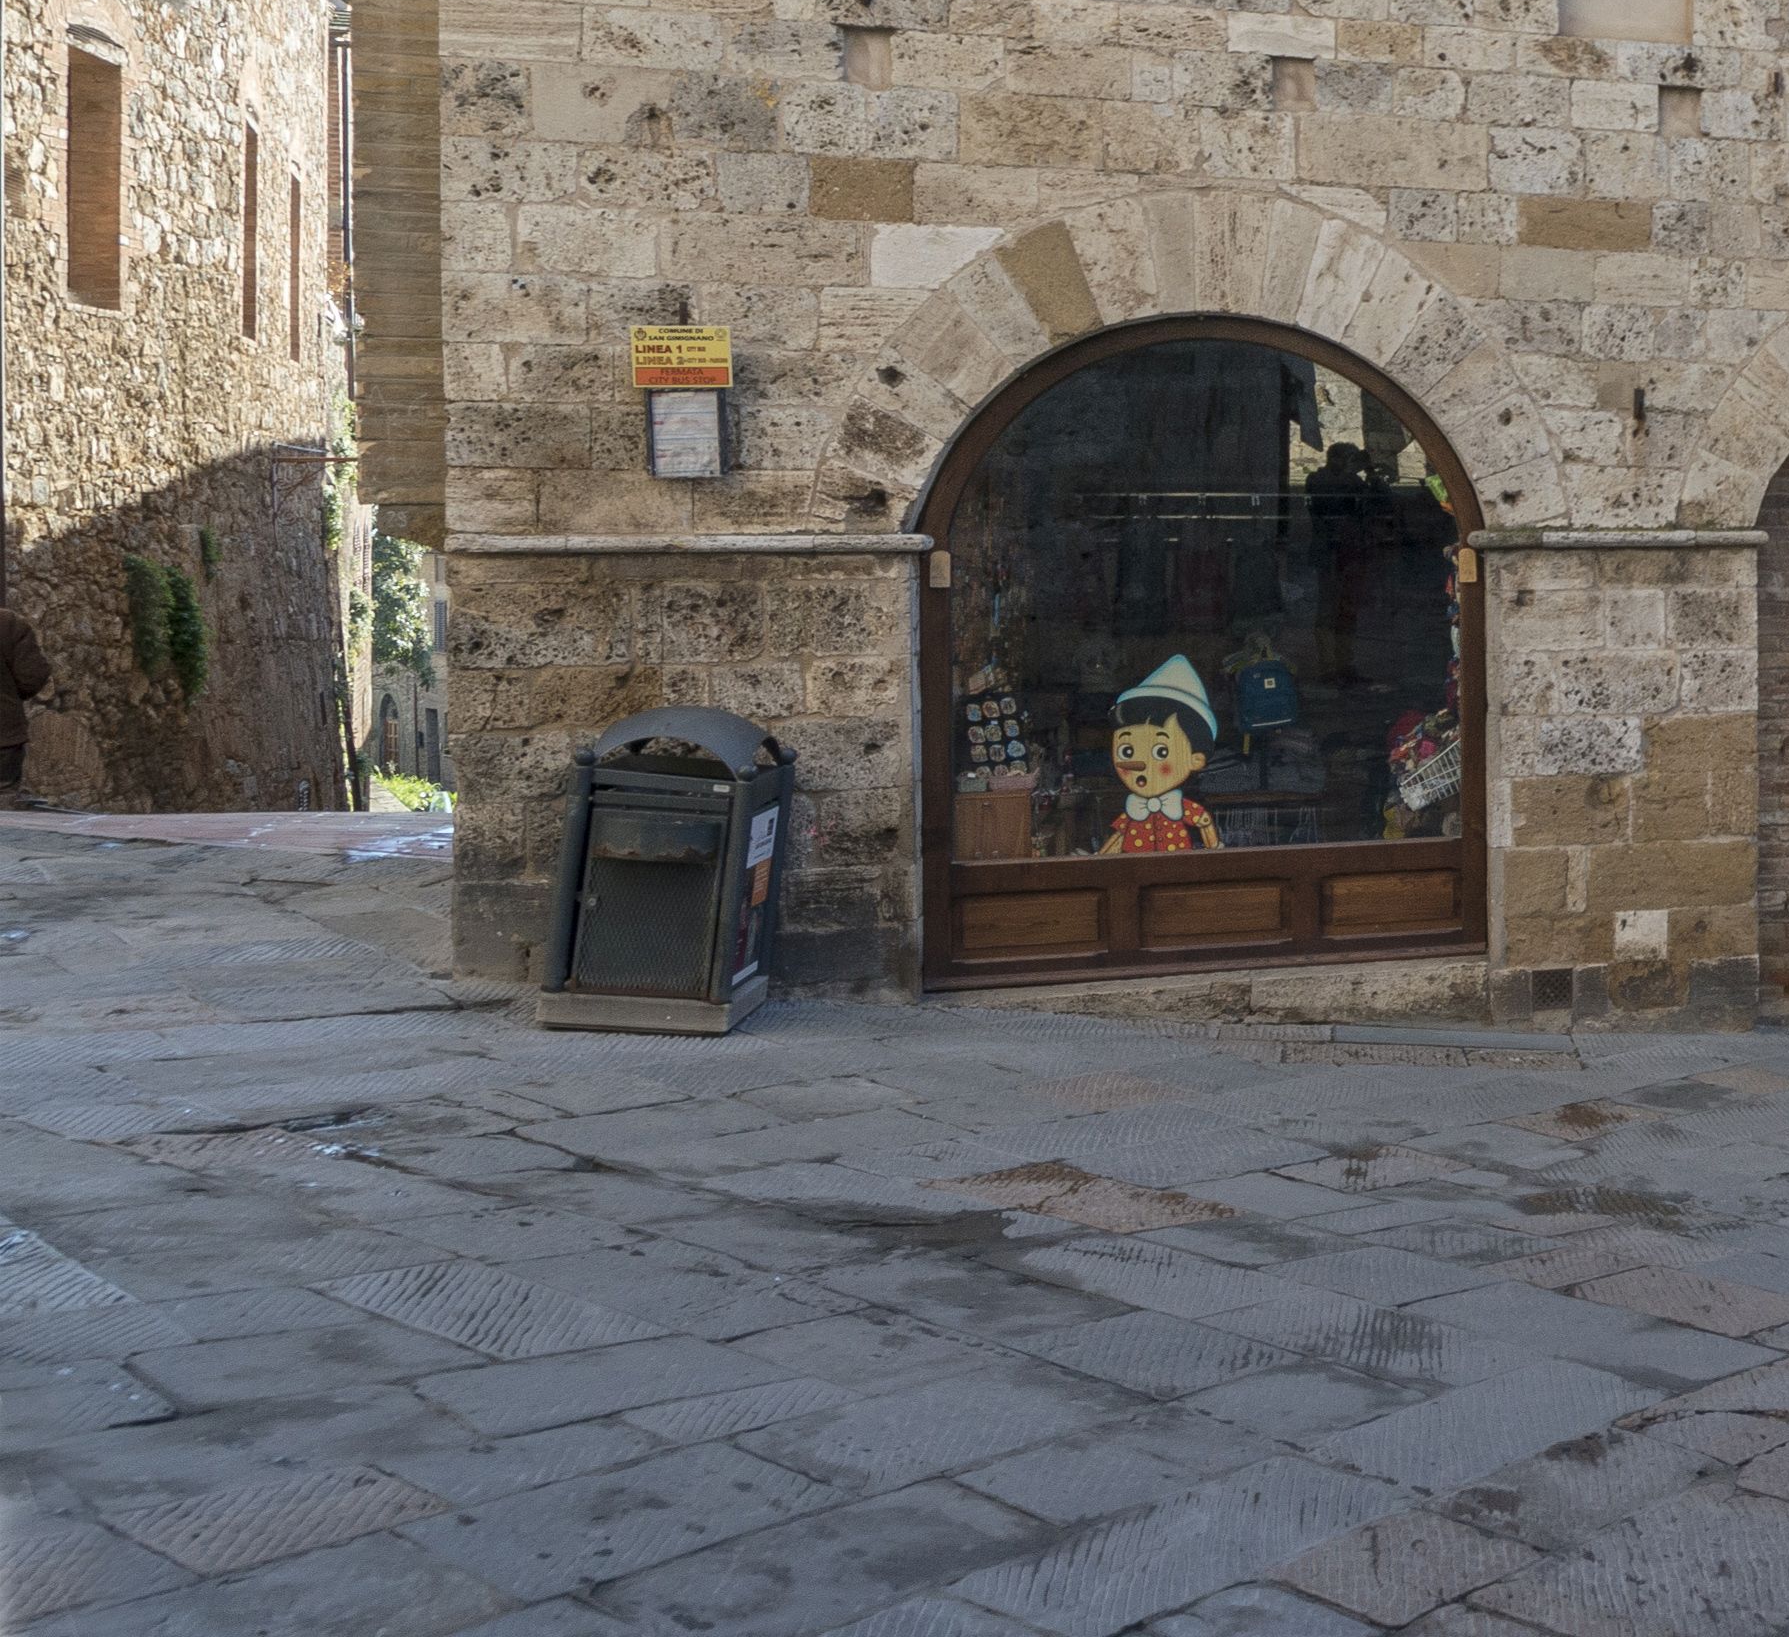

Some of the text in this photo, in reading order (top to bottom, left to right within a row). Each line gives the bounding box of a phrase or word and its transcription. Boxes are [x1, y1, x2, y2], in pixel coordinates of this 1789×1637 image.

[635, 345, 672, 354] LINEA
[676, 345, 682, 354] 1
[636, 356, 673, 365] LINEA
[693, 376, 716, 384] STOP
